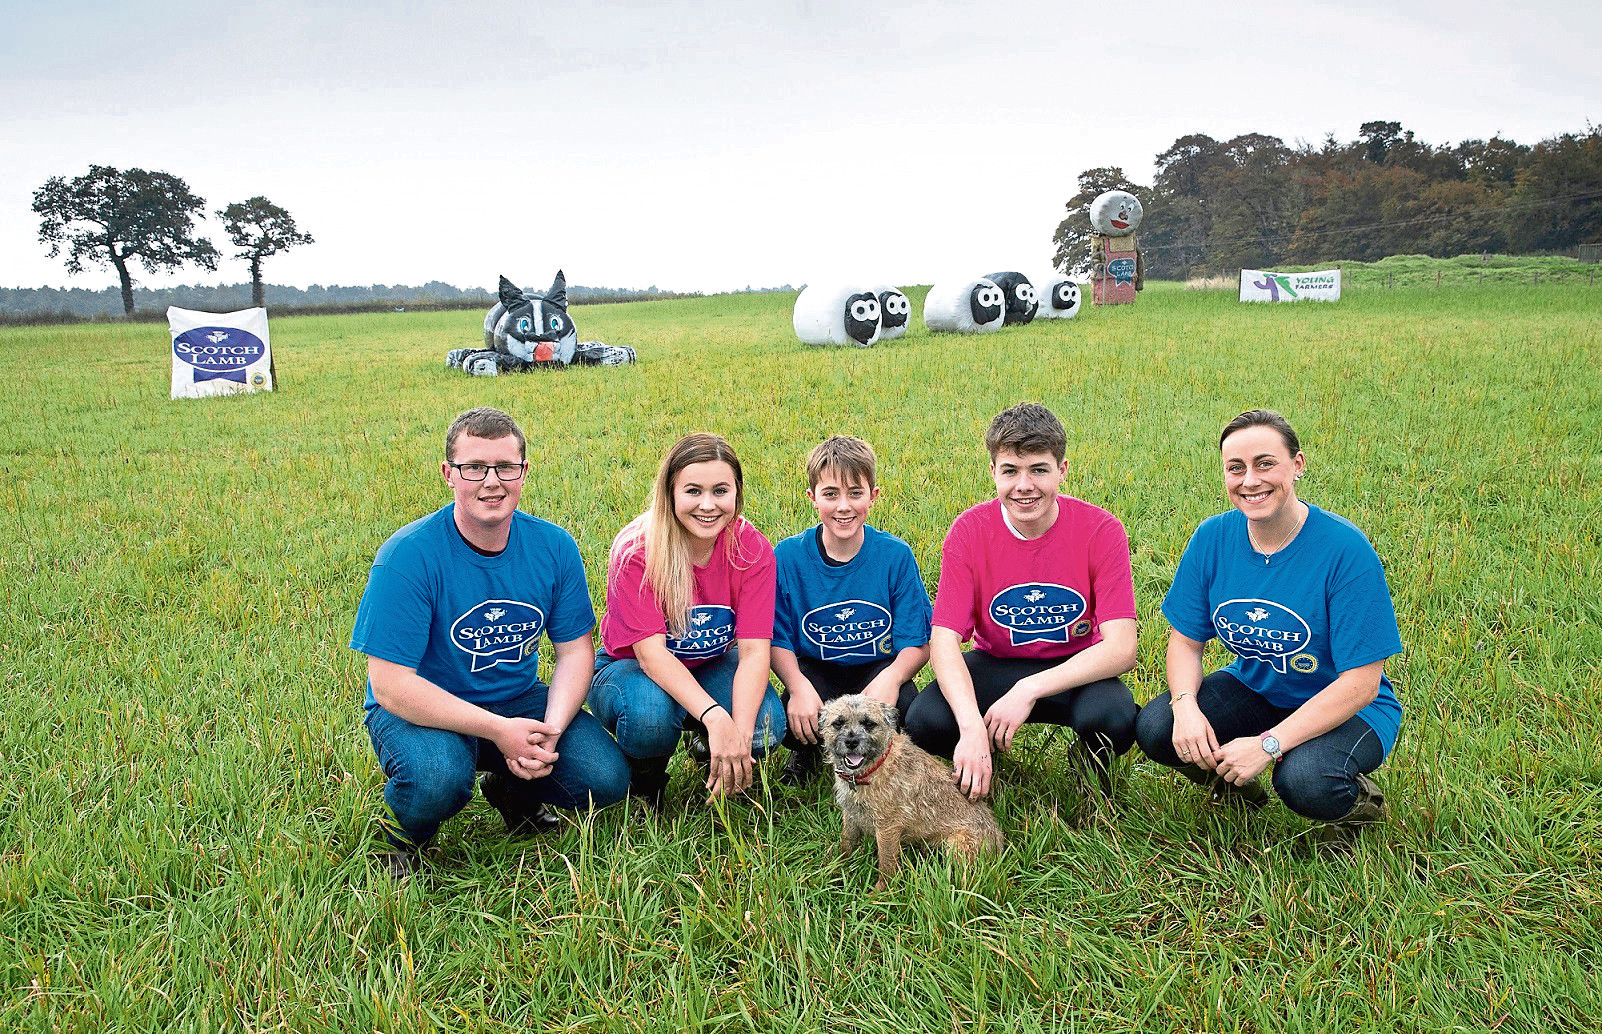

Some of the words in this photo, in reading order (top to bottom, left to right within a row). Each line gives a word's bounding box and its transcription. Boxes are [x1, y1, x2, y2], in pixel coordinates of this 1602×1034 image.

[1296, 276, 1335, 284] YOUNG
[176, 342, 260, 355] SCOTCH
[190, 353, 247, 365] LAMB
[995, 603, 1079, 616] SCOTCH
[808, 618, 886, 634] SCOTCH
[1008, 614, 1066, 626] LAMB
[458, 620, 537, 640] SCOTCH
[1217, 616, 1302, 642] SCOTCH
[473, 634, 523, 650] LAMB
[674, 635, 729, 650] LAMB
[819, 631, 874, 643] LAMB
[1226, 630, 1284, 652] LAMB
